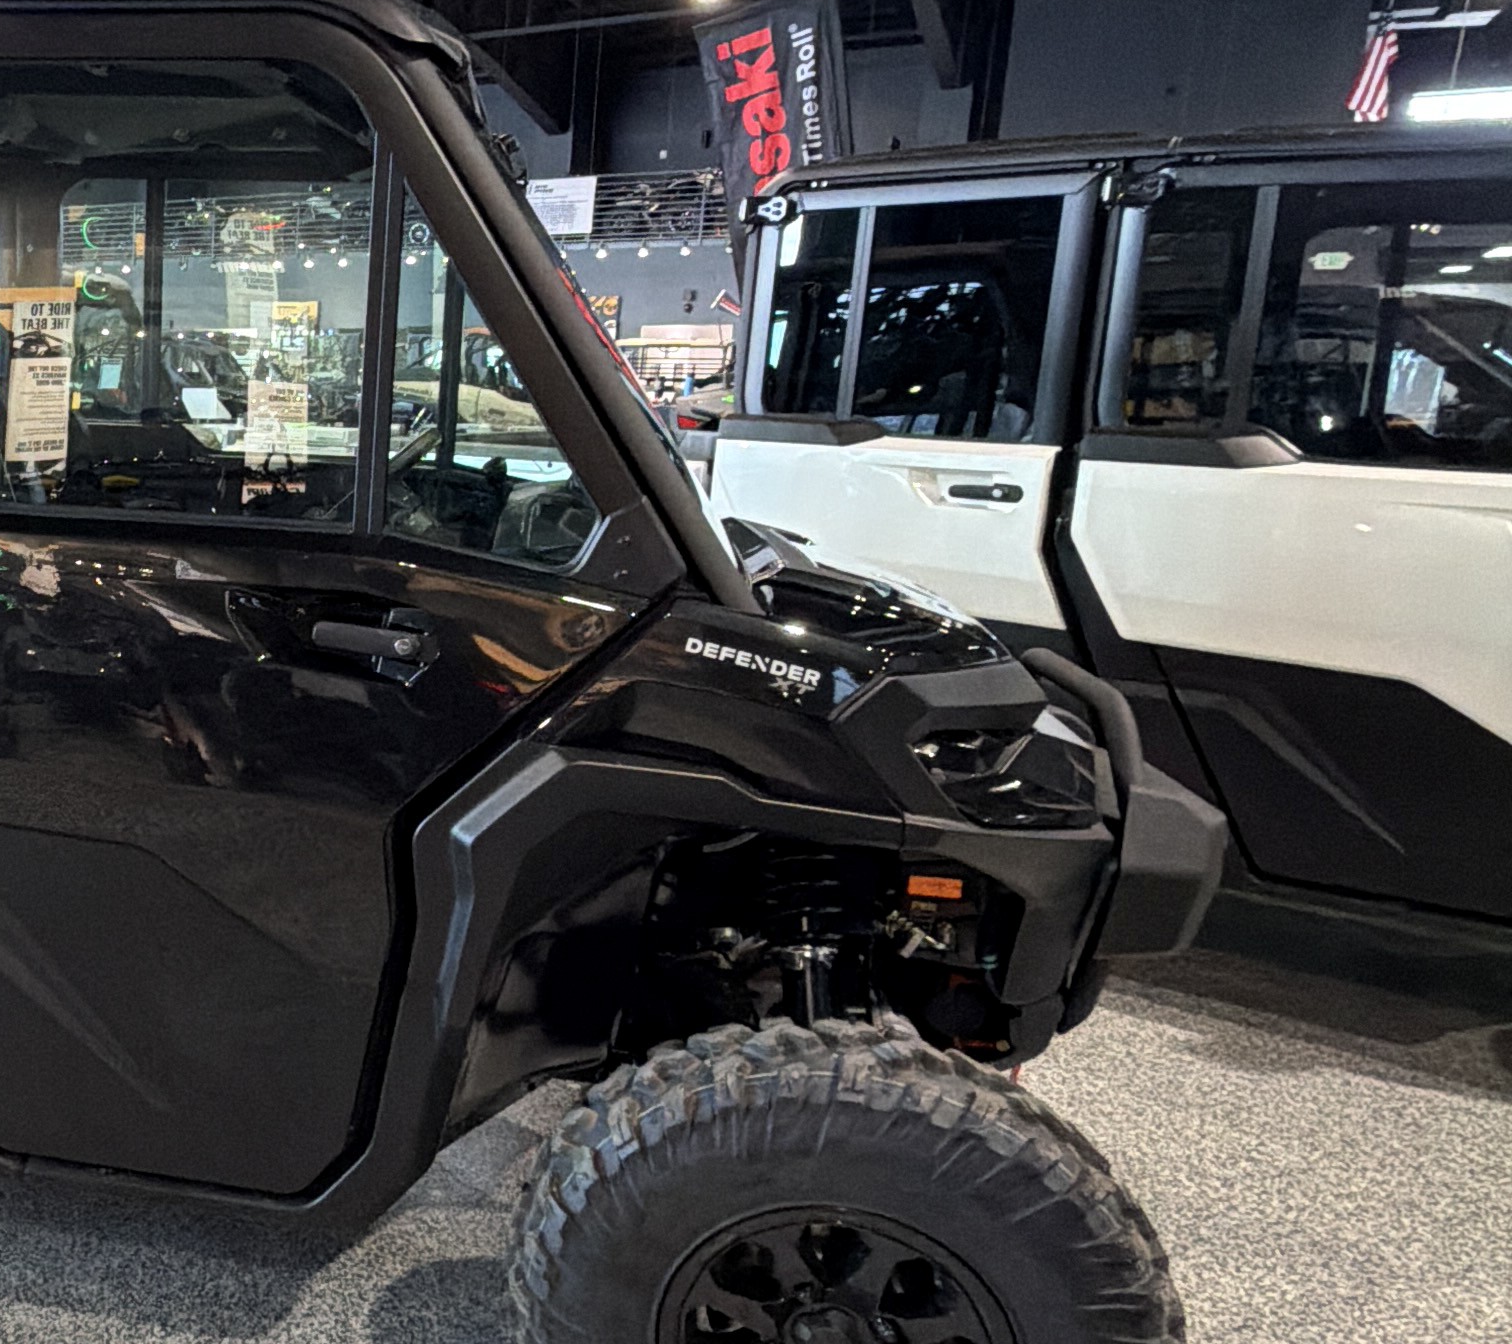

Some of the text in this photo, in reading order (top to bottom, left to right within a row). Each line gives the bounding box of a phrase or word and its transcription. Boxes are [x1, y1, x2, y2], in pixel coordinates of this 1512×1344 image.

[716, 27, 792, 197] saki
[801, 84, 824, 166] Times
[684, 636, 822, 687] DEFENDER
[768, 676, 817, 696] XT
